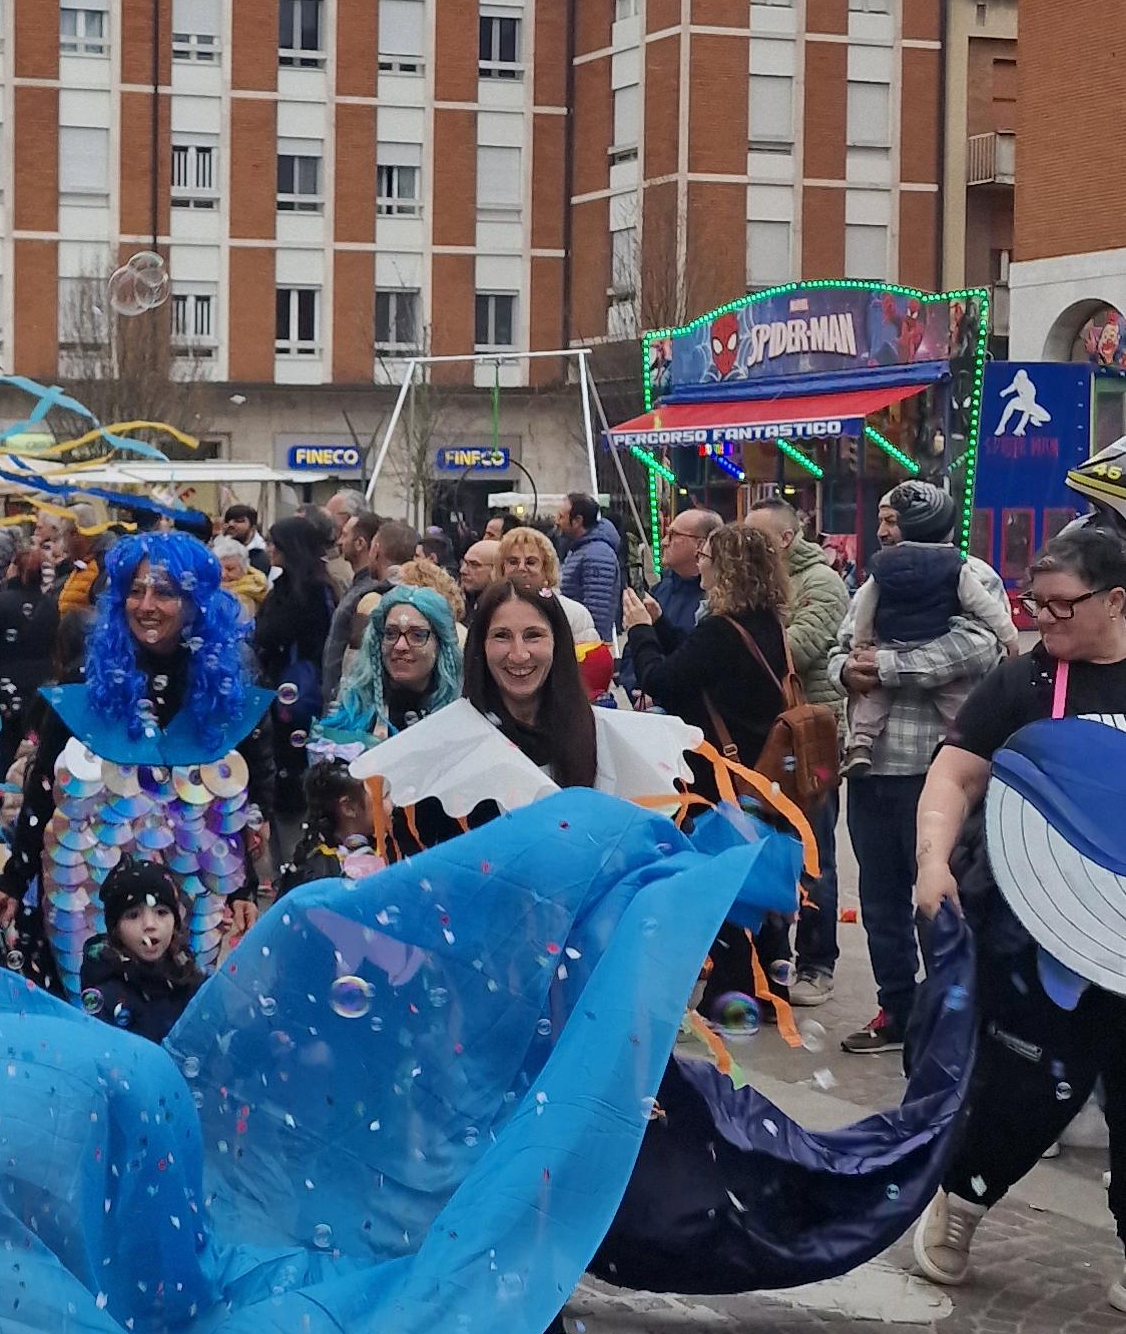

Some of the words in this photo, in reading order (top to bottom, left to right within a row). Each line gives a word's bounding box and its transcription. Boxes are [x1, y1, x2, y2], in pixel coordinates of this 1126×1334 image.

[612, 430, 708, 447] PERCORSO
[712, 421, 842, 442] FANTASTICO
[294, 448, 360, 466] FINECO
